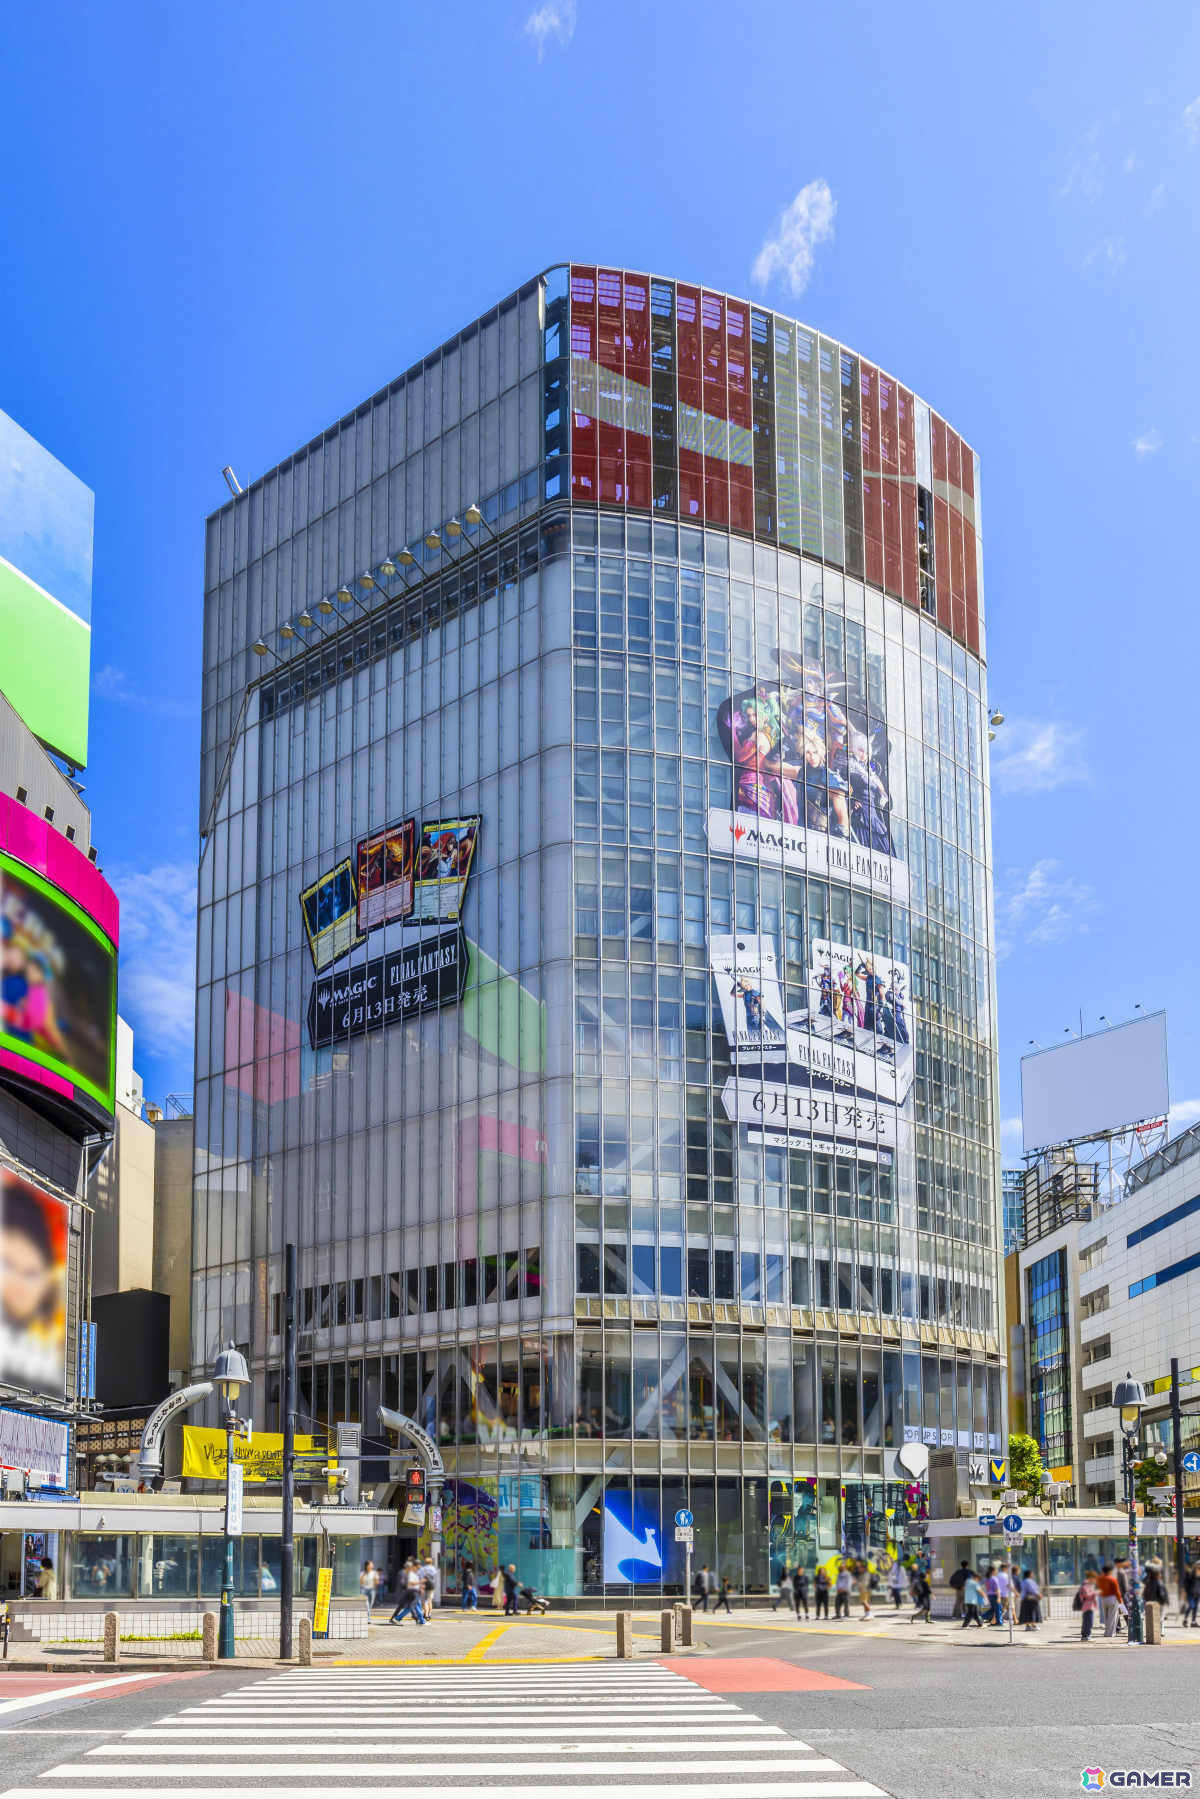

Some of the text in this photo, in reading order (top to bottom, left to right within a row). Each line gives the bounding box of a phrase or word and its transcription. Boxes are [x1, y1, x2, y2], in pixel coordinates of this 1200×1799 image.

[746, 828, 808, 854] MAGIC
[390, 943, 457, 985] FINAL FANTASY
[825, 949, 854, 963] MAGIC
[733, 965, 765, 975] MAGIC
[332, 975, 378, 1002] MAGIC
[342, 983, 429, 1028] 6月13日発売
[798, 1043, 821, 1066] FIAL
[752, 1090, 886, 1134] 6月13日発売
